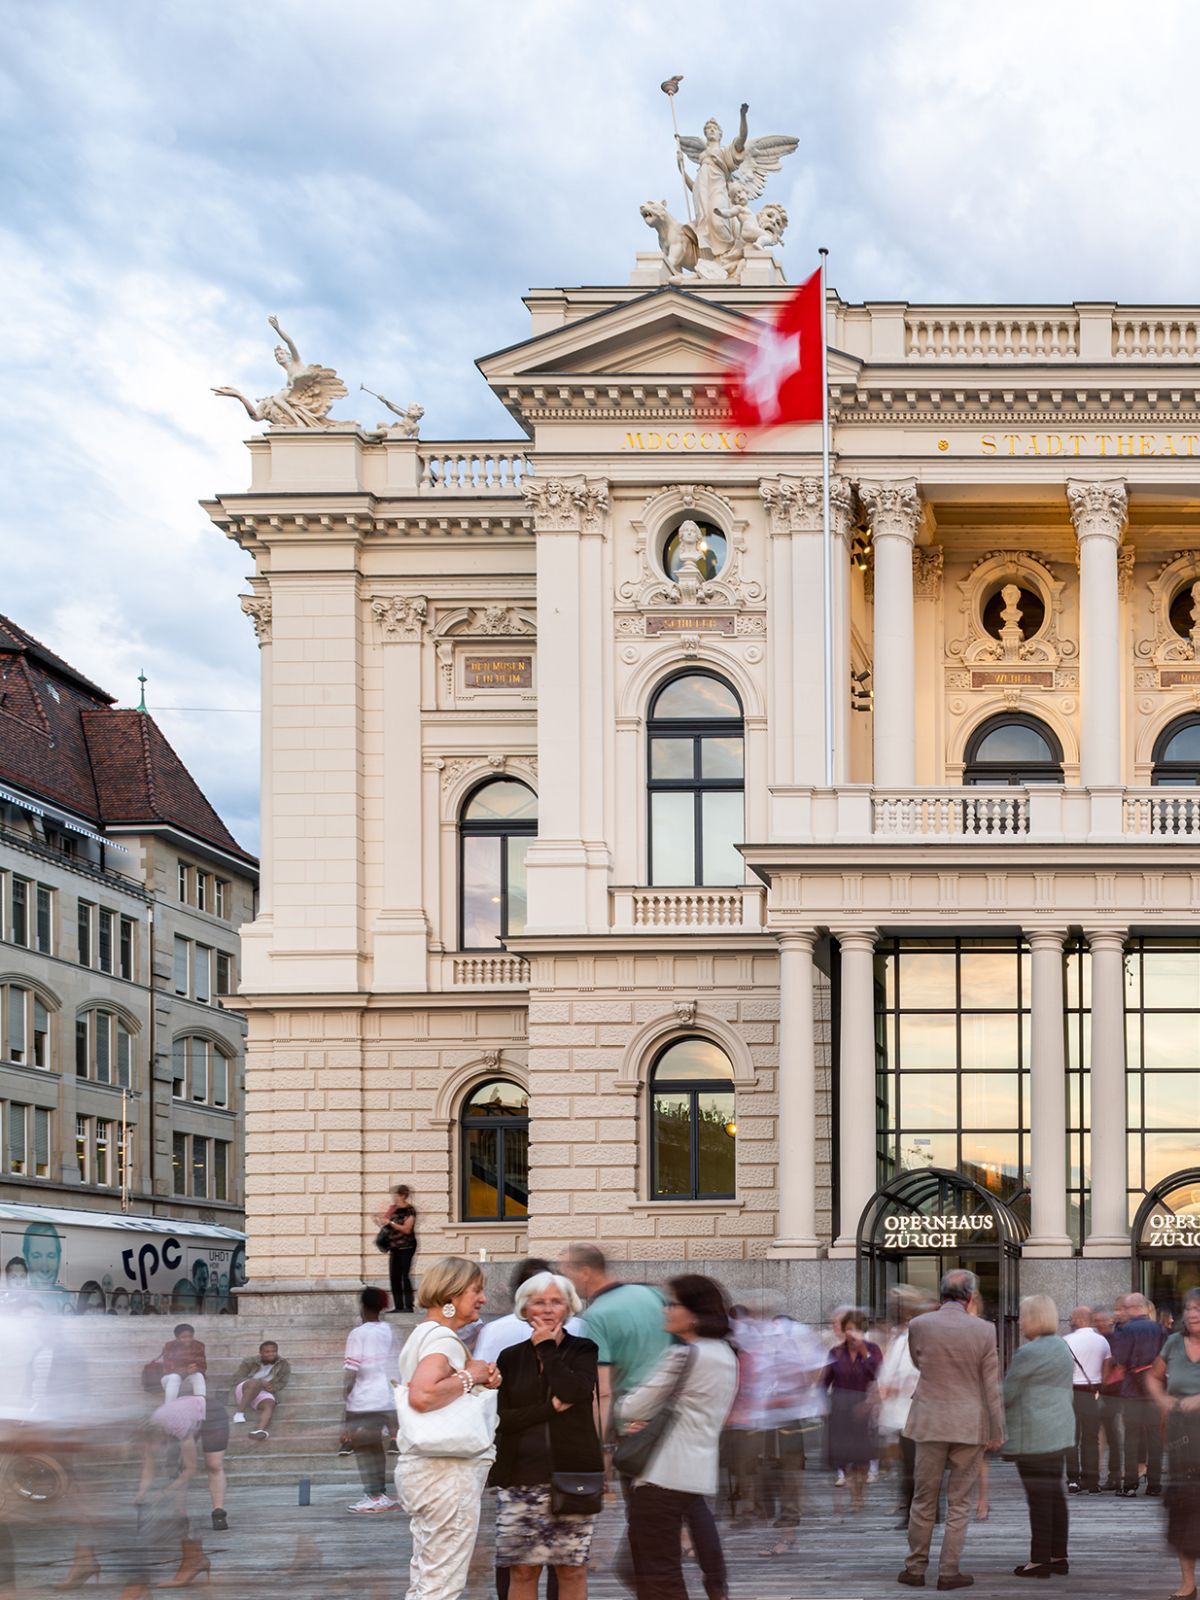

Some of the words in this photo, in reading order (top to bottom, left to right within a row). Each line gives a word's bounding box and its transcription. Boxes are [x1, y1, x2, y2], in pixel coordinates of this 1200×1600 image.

[621, 431, 749, 450] MDCCCXC
[884, 1215, 993, 1231] OPERNHAUS
[884, 1230, 958, 1248] ZÜRICH
[122, 1238, 182, 1290] tpc
